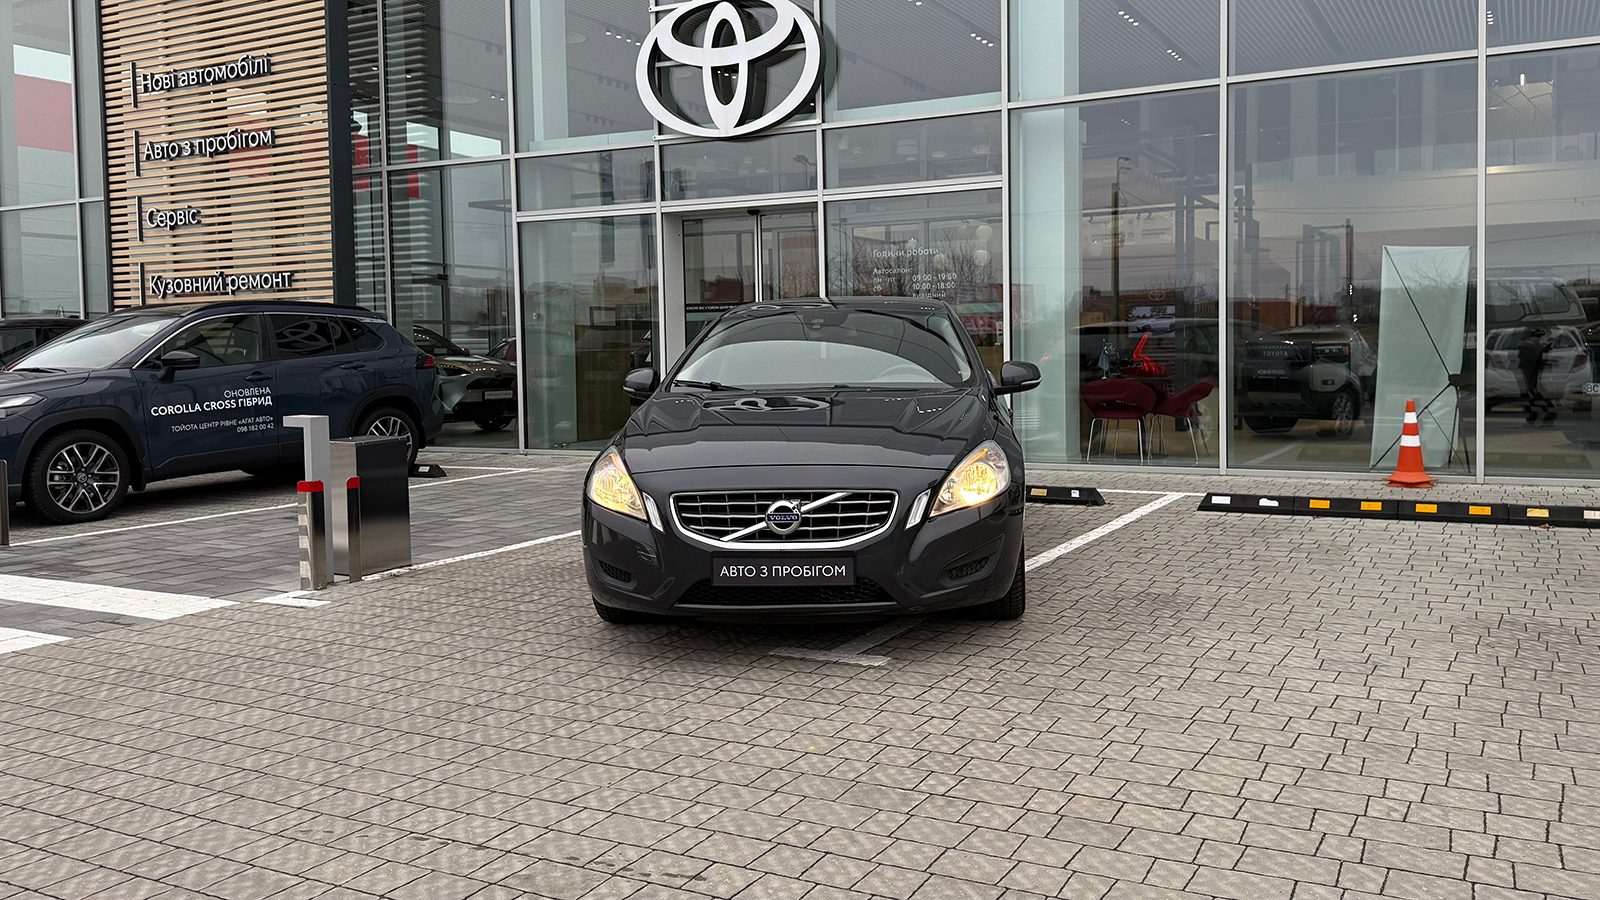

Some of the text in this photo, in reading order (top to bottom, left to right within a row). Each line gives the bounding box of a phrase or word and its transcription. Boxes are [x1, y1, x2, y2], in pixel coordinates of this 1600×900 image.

[140, 52, 271, 93] Нові автомобілі
[143, 128, 273, 161] Авто з пробігом
[146, 205, 199, 231] Сервіс
[872, 249, 905, 258] Години
[872, 266, 912, 275] Автосалон:
[149, 271, 292, 299] Кузовний ремонт
[936, 282, 956, 290] 18:00
[224, 386, 272, 398] ОНОВЛЕНА
[150, 396, 273, 416] COROLLA CROSS ГІБРИД
[171, 424, 199, 432] ТОЙОТА
[200, 421, 220, 430] ЦЕНТР
[720, 565, 756, 577] АВТО
[772, 565, 846, 577] ПРОБІГОМ
